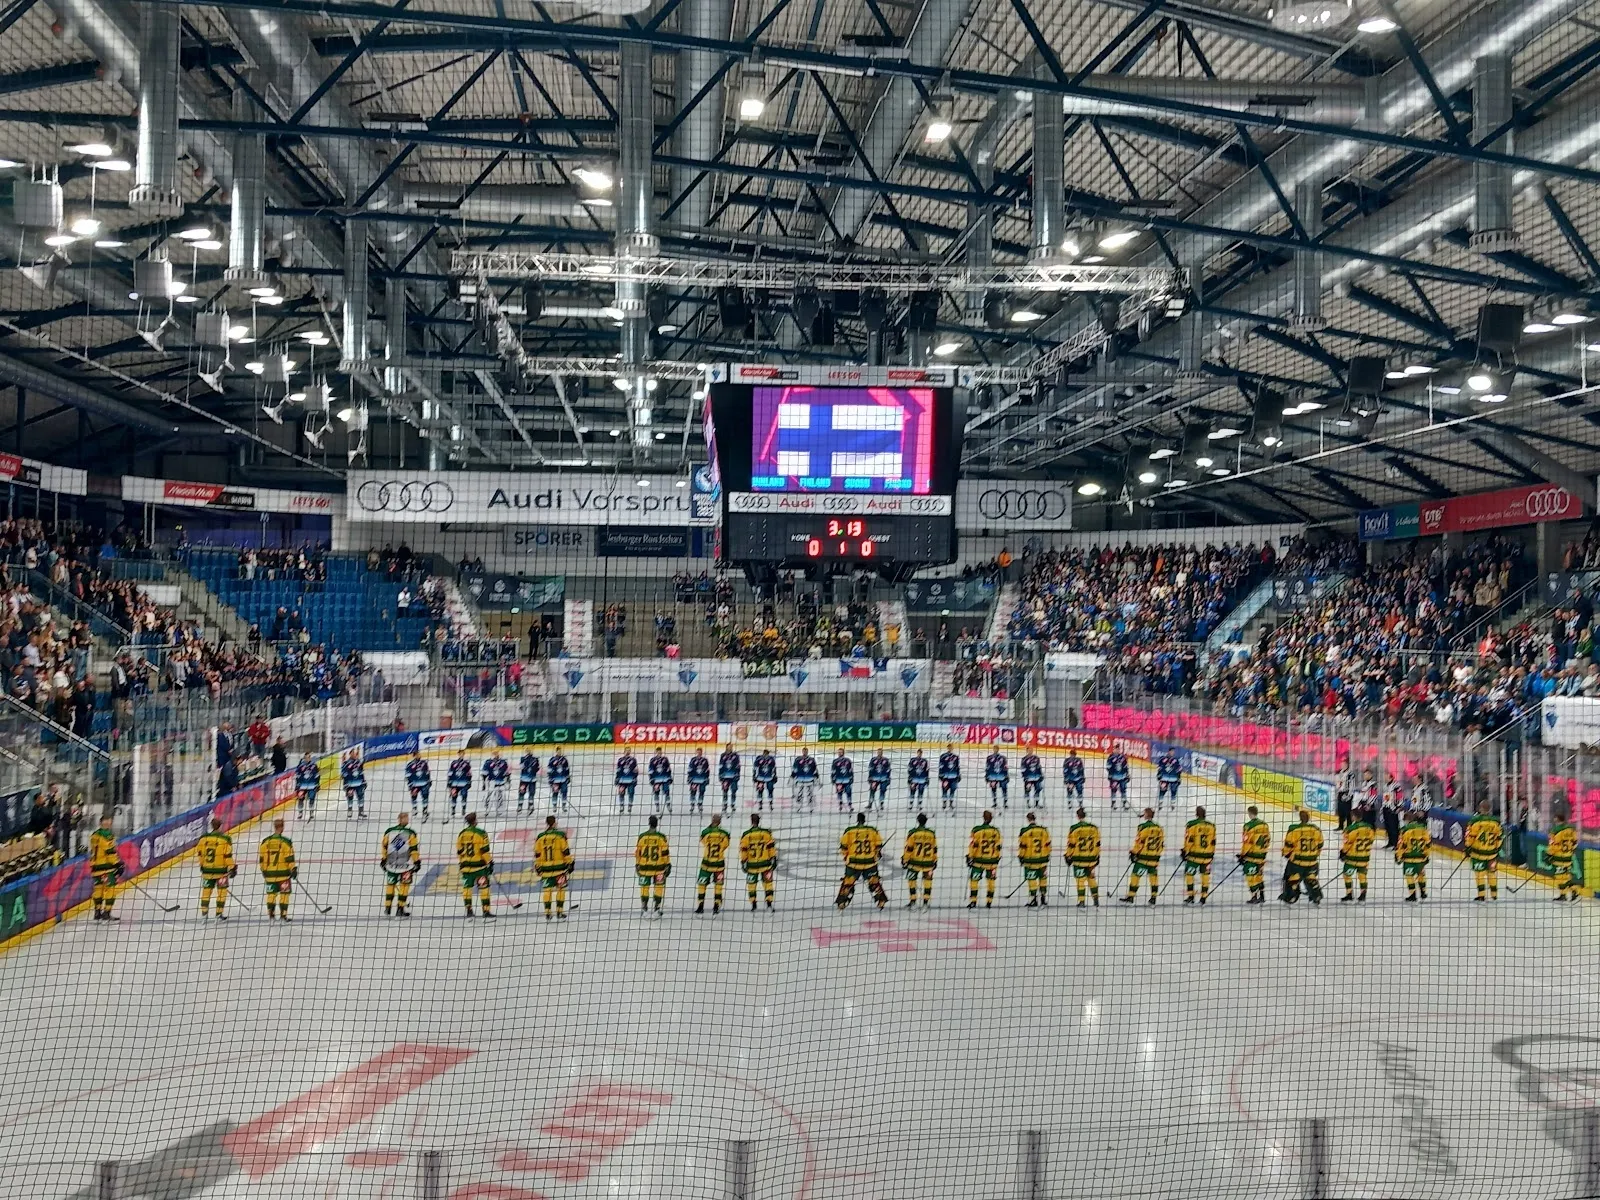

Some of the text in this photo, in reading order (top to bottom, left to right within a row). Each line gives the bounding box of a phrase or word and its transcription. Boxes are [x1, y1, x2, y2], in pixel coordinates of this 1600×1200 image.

[487, 488, 563, 509] Audi
[779, 497, 815, 509] Audi
[866, 498, 902, 510] Audi
[808, 540, 820, 556] 0
[861, 541, 873, 556] 0
[635, 726, 713, 741] STRAUSS
[1037, 731, 1098, 750] STRAUSS
[707, 843, 720, 858] 12
[915, 842, 931, 857] 72
[1033, 839, 1042, 853] 3
[267, 850, 280, 866] 17
[544, 846, 554, 862] 11
